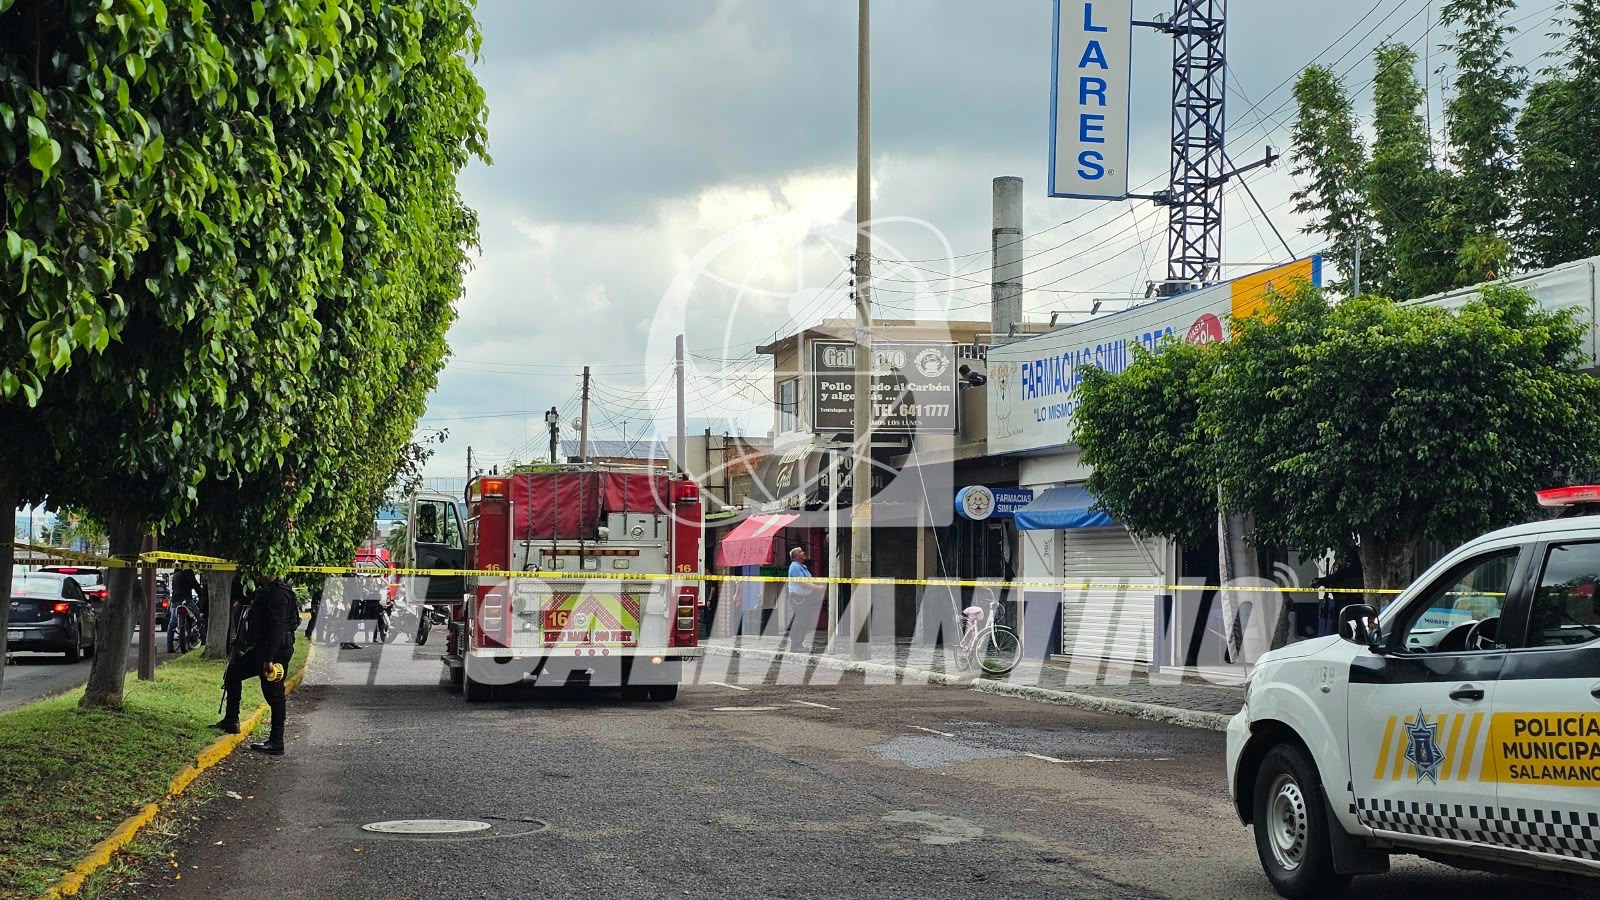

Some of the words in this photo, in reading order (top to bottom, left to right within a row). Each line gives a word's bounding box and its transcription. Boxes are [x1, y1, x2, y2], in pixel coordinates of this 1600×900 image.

[820, 381, 852, 391] Pollo
[893, 383, 905, 391] al
[907, 382, 951, 392] Carbón
[820, 393, 829, 401] y
[873, 403, 897, 416] TEL.
[900, 404, 922, 417] 641
[924, 404, 950, 417] 1777
[1049, 401, 1073, 420] MISMO
[996, 493, 1032, 502] FARMACIAS
[485, 563, 501, 571] 16
[677, 564, 692, 573] 16
[549, 611, 568, 627] 16
[1514, 714, 1600, 737] POLICÍA
